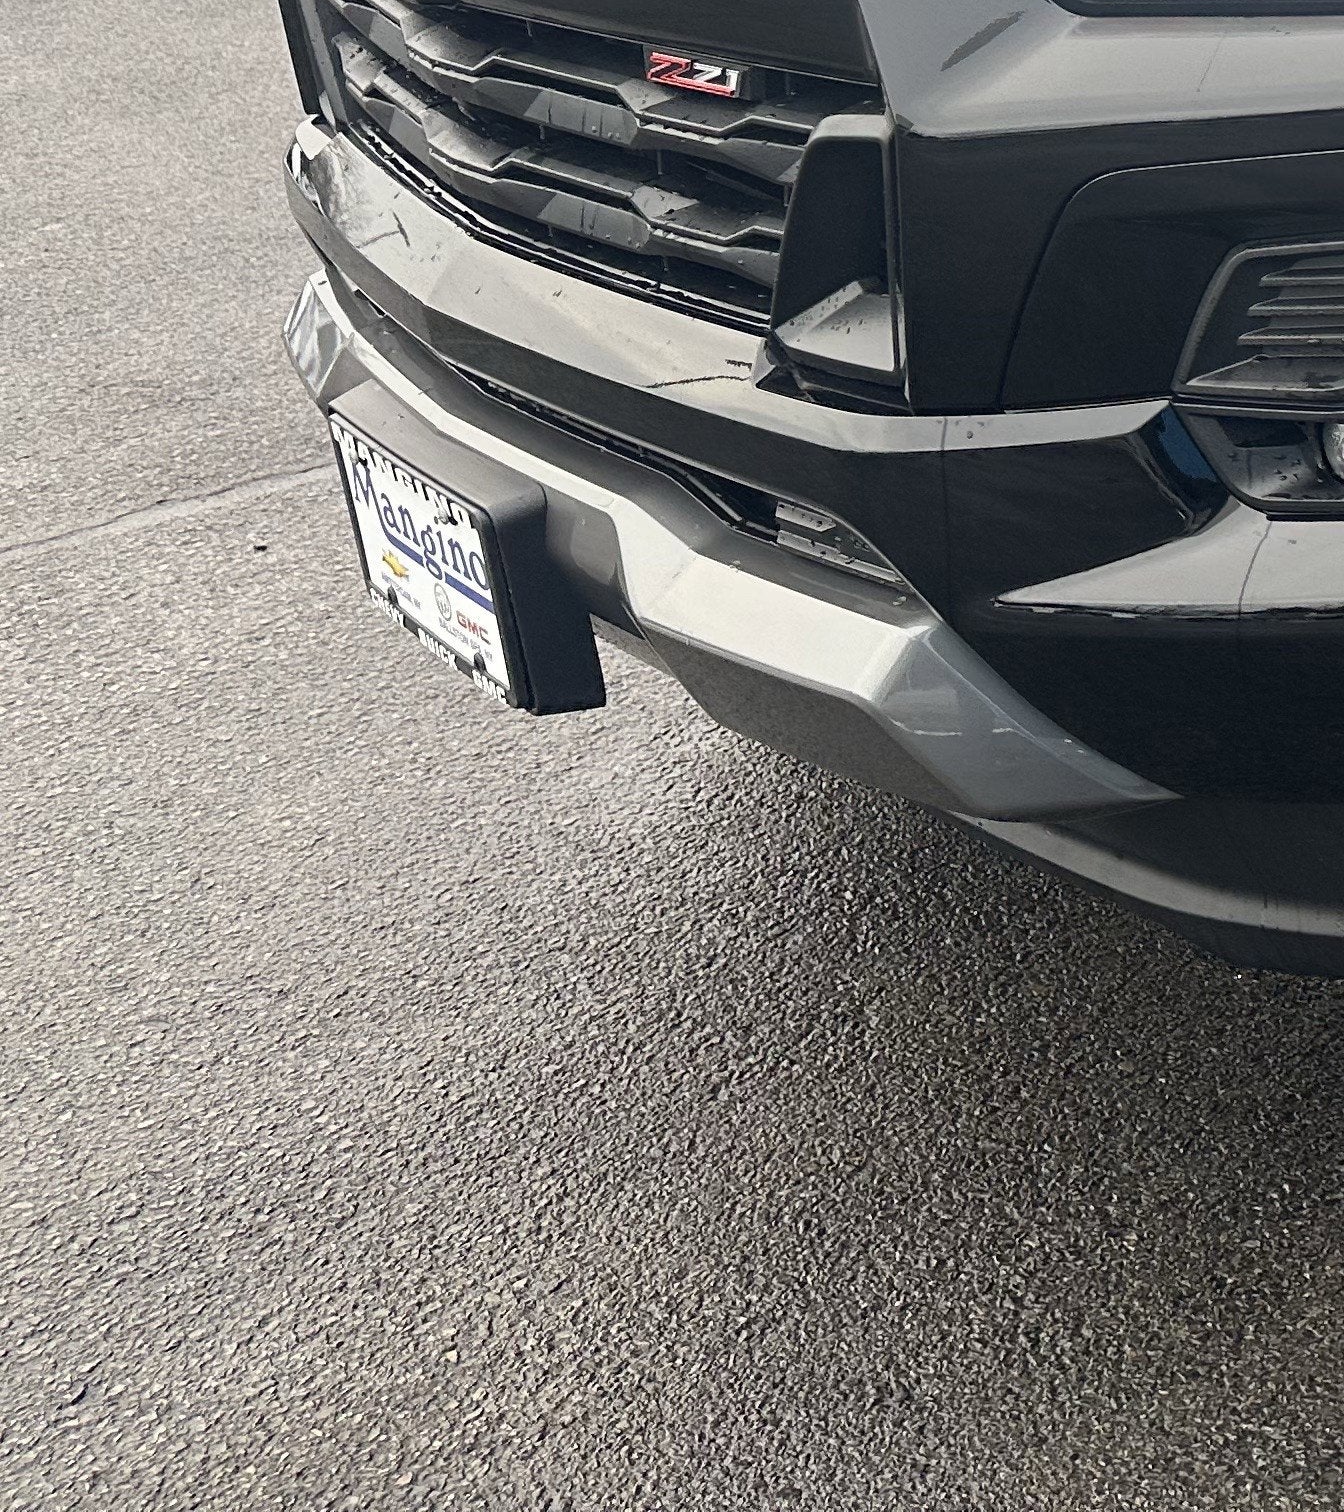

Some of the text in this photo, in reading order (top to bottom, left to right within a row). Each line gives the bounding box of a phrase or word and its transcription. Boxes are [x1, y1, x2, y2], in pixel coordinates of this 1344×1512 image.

[647, 51, 740, 99] Z71
[331, 420, 478, 530] MANGINO
[352, 462, 491, 591] Mangino
[370, 587, 405, 625] CHEVY
[418, 627, 460, 671] BUICK
[472, 669, 508, 705] GMC
[456, 610, 491, 645] GMC
